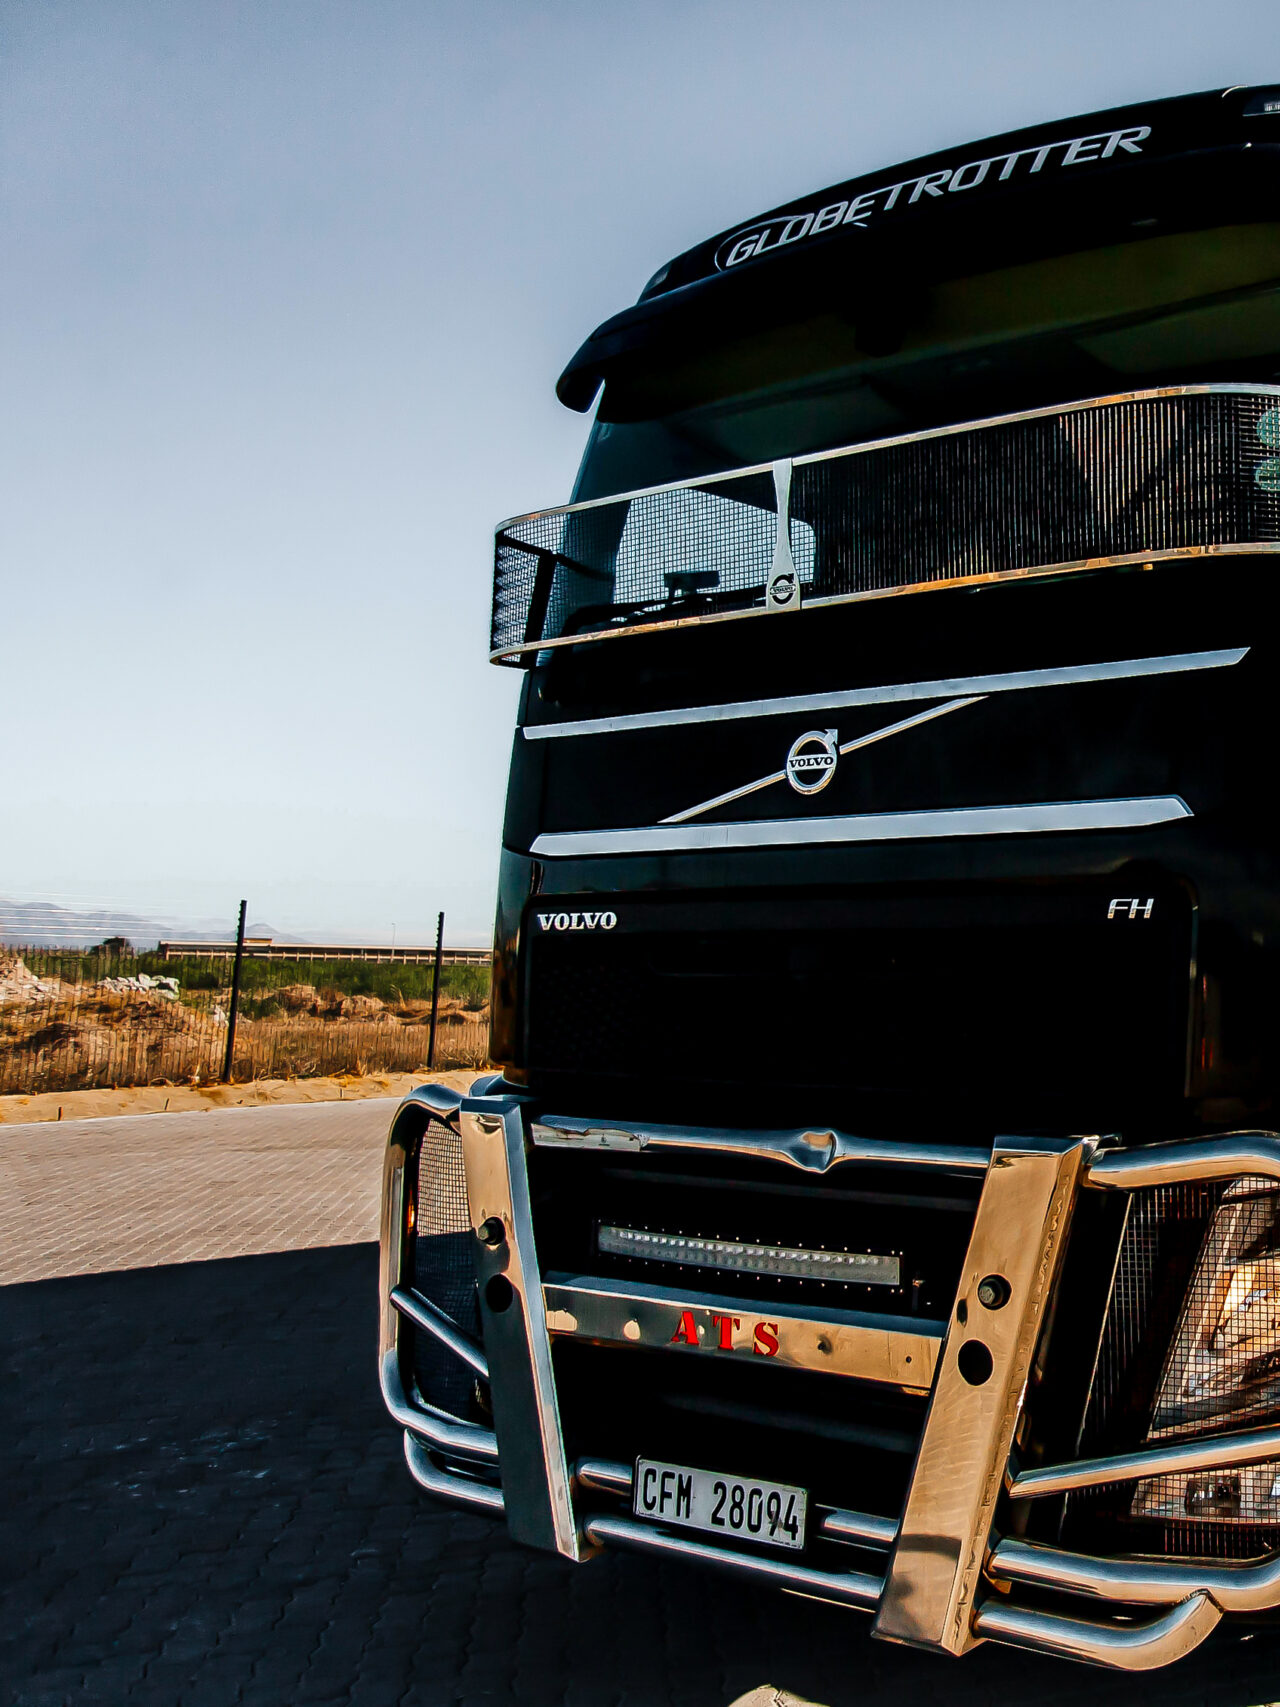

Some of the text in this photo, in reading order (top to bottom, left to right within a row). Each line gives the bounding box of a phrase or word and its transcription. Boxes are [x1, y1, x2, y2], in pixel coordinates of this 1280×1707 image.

[725, 126, 1152, 267] GLOBETROTTER
[789, 757, 834, 768] VOLVO
[537, 911, 617, 931] VOLVO
[1107, 898, 1154, 919] FH
[671, 1311, 780, 1357] ATS
[643, 1468, 799, 1541] CFM 28094
